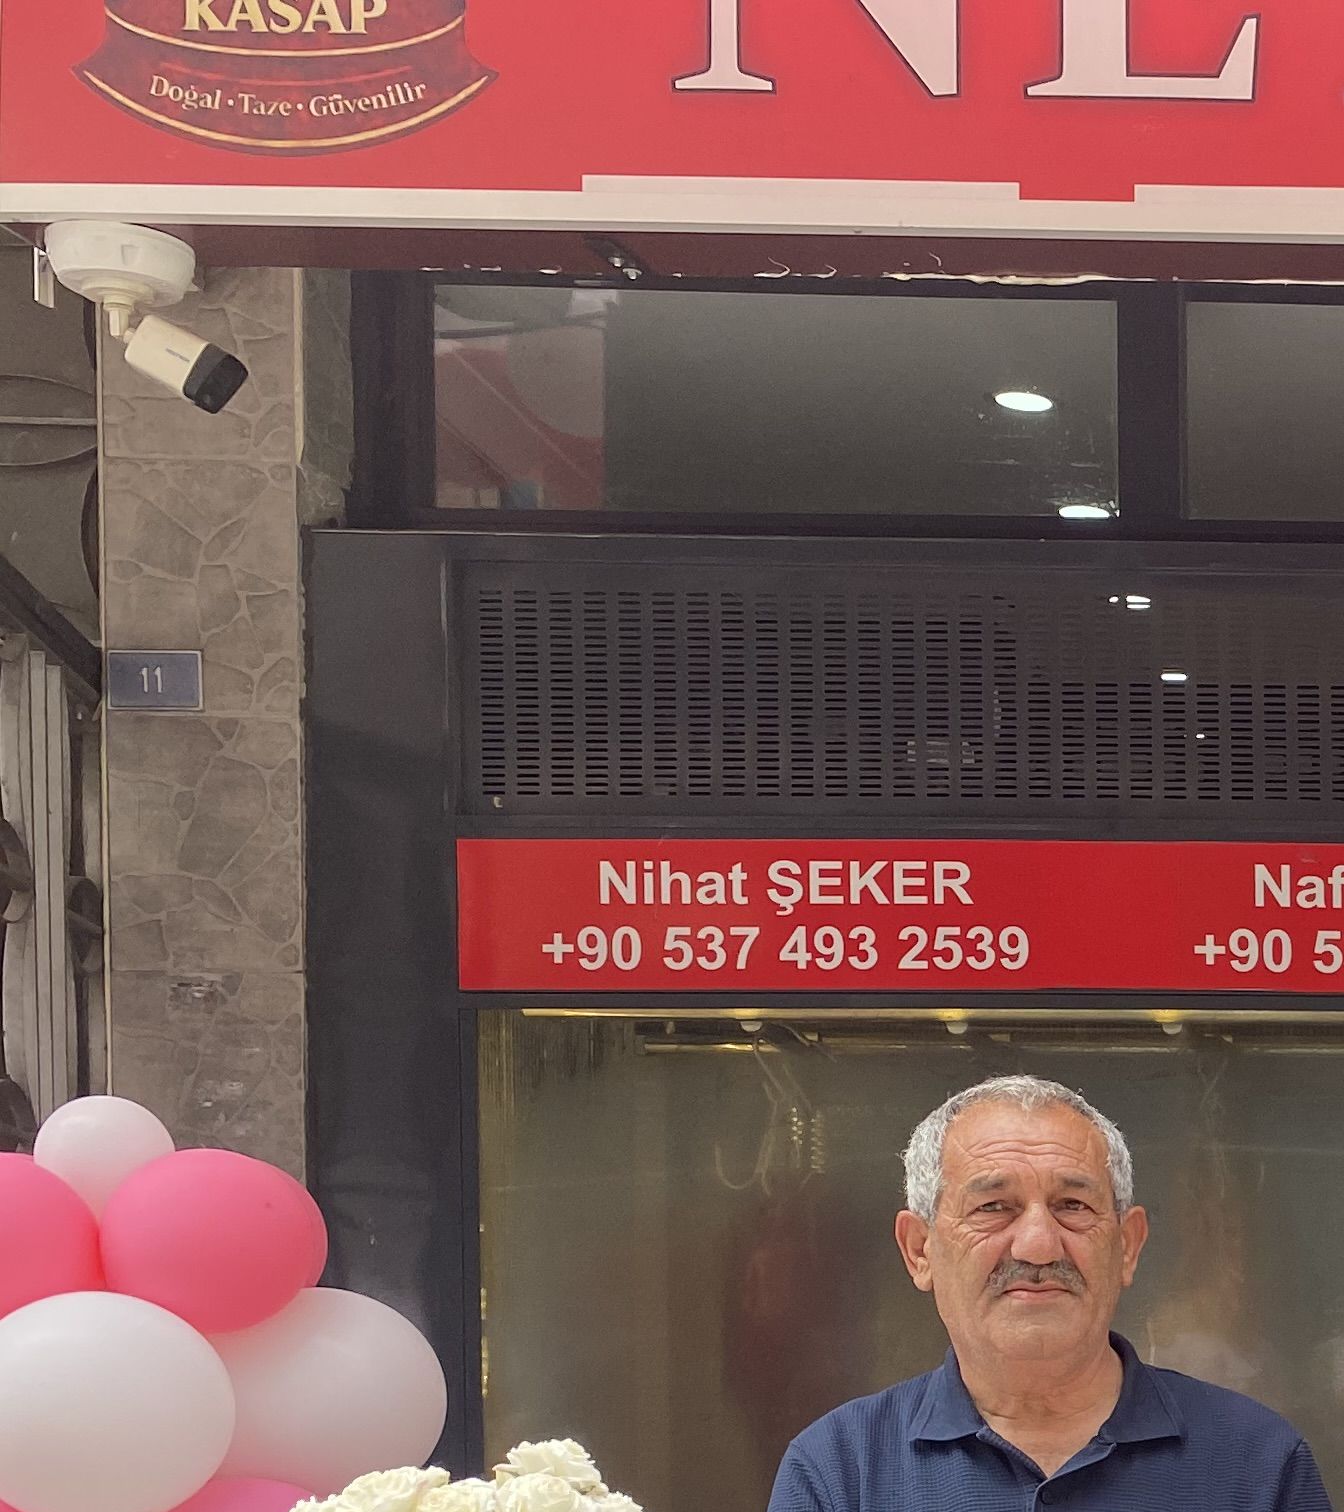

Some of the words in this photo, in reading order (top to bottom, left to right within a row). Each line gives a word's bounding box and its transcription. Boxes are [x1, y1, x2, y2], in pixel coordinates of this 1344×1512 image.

[182, 0, 388, 34] KASAP
[150, 75, 222, 110] Doğal
[238, 93, 292, 116] Taze
[309, 82, 426, 117] Güvenilir
[141, 666, 162, 693] 11
[599, 860, 749, 905] Nihat
[766, 860, 974, 915] ŞEKER
[541, 926, 642, 971] +90
[662, 926, 760, 971] 537
[778, 926, 879, 971] 493
[898, 926, 1030, 971] 2539
[1193, 928, 1293, 973] +90
